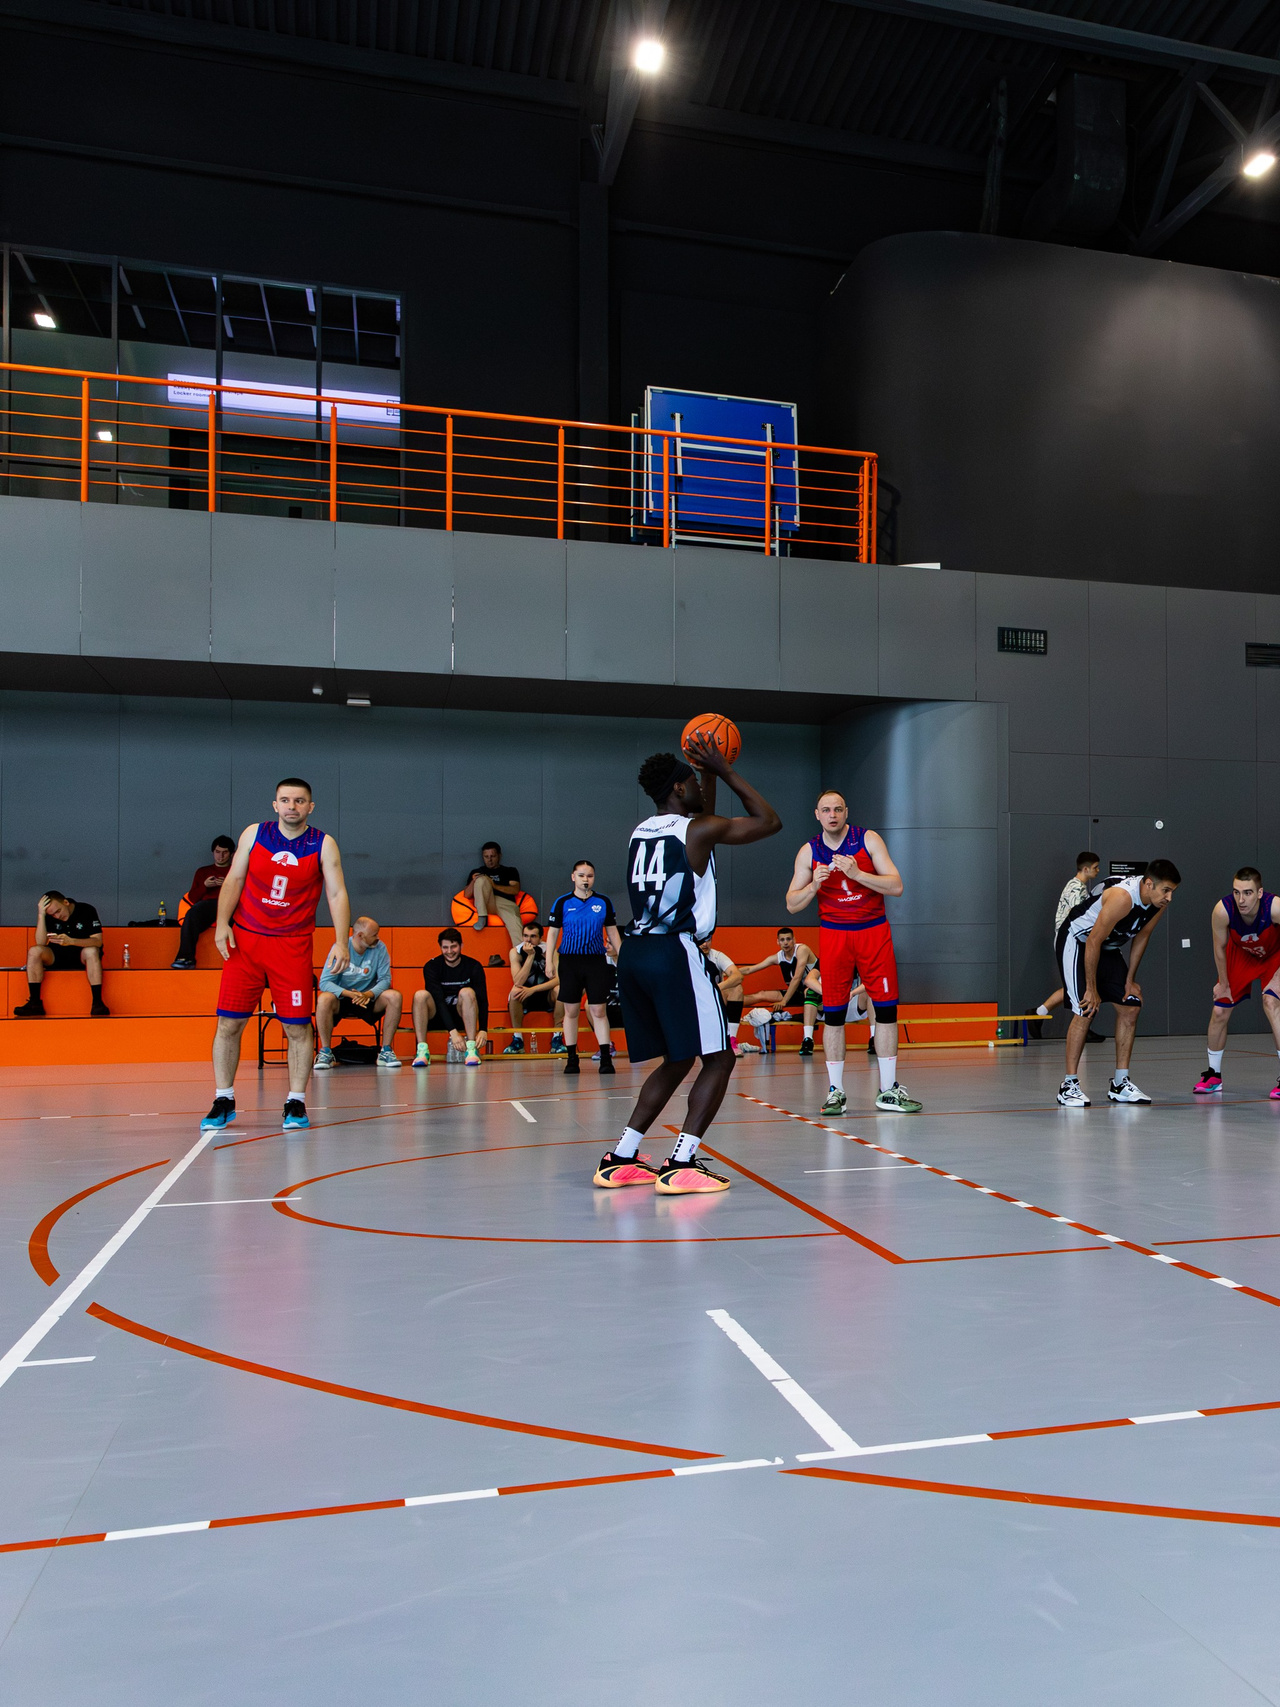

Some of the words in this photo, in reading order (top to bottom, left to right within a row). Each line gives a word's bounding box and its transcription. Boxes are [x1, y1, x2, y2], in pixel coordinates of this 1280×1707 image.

[631, 839, 667, 892] 44
[270, 874, 289, 900] 9
[882, 977, 889, 993] 1
[291, 990, 302, 1007] 9
